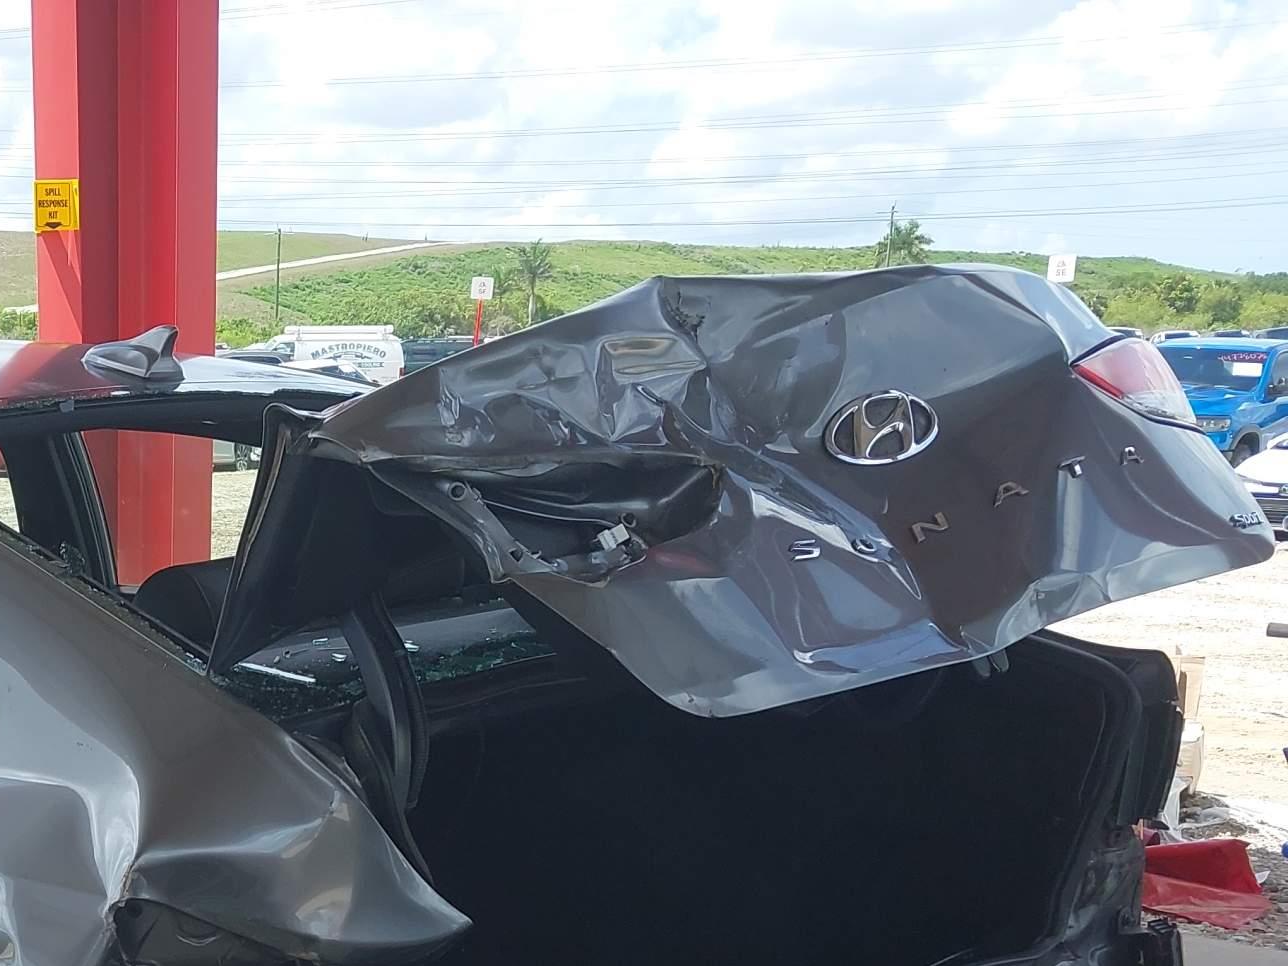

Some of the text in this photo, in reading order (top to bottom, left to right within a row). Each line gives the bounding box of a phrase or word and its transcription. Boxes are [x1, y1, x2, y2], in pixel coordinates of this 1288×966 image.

[45, 187, 61, 196] SPILL
[38, 199, 69, 208] RESPONSE
[48, 210, 58, 219] KIT
[310, 342, 387, 360] MASTROPIERO
